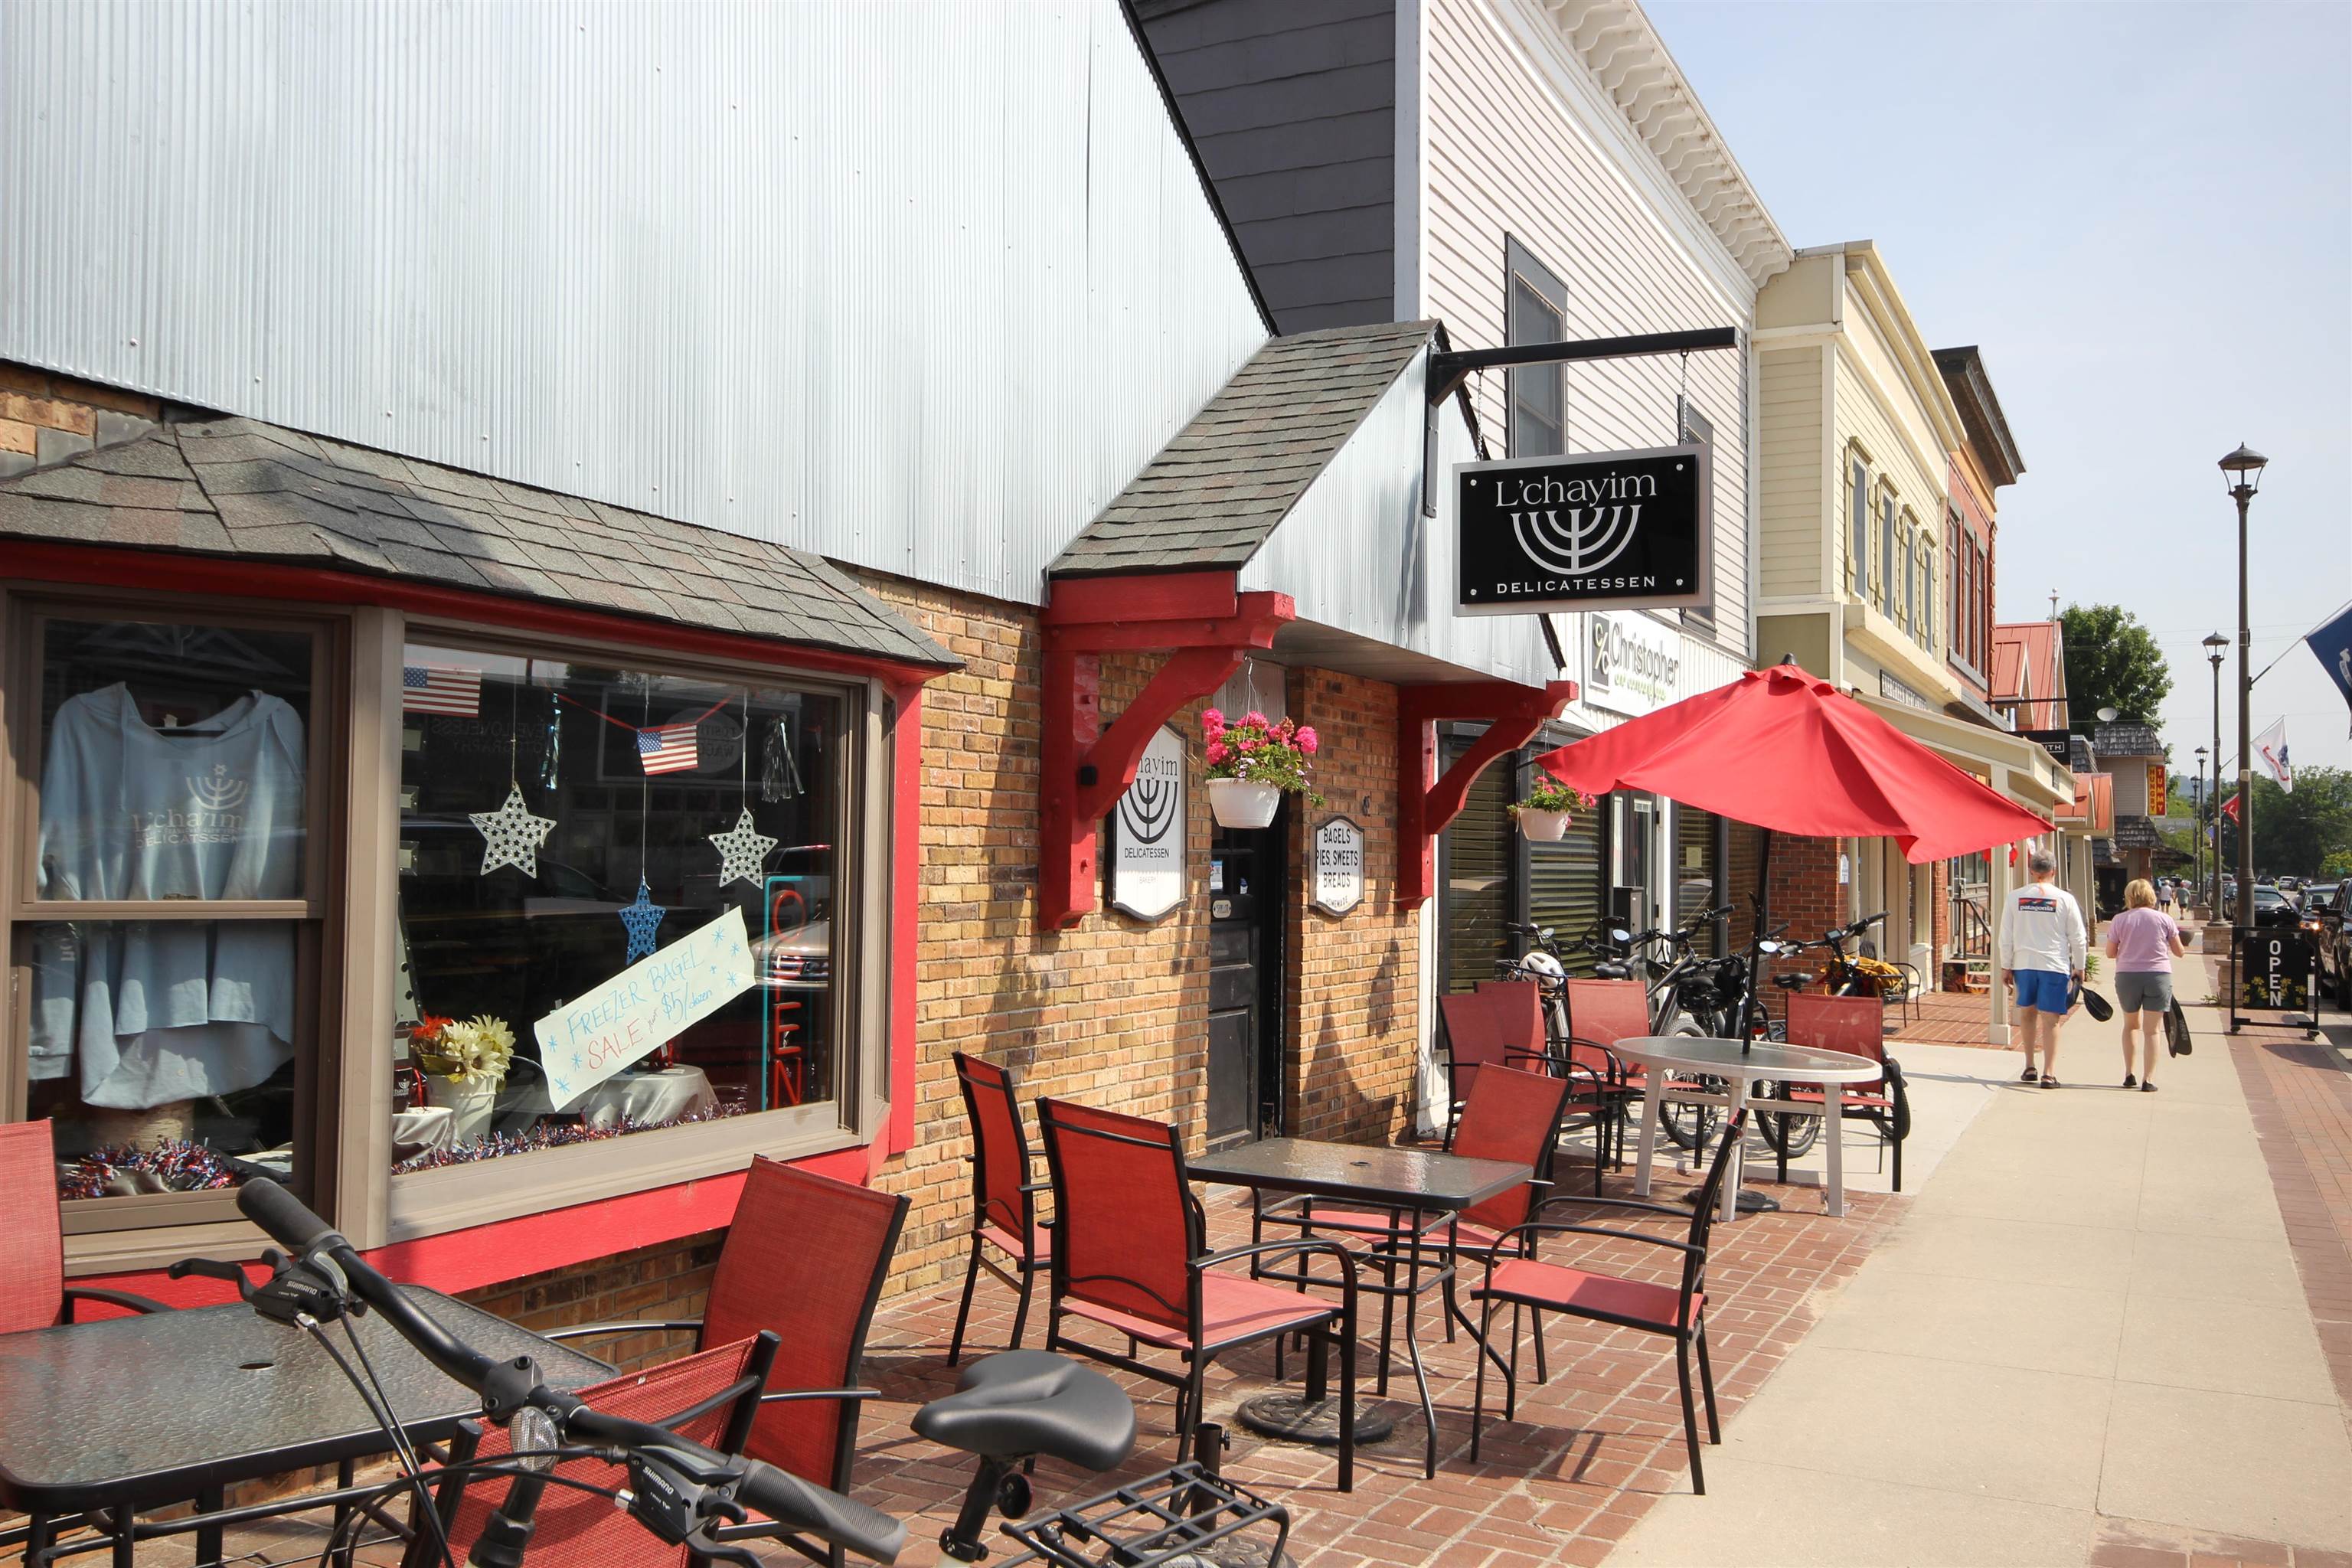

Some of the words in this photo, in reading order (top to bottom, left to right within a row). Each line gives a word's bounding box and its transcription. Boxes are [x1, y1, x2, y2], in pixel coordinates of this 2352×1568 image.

[1495, 472, 1658, 508] L'chayim
[1497, 576, 1655, 594] DELICATESSEN
[1610, 622, 1679, 707] Christopher
[1324, 827, 1351, 844] BAGELS
[1124, 848, 1170, 858] DELICATESSEN
[1333, 850, 1358, 866] SWEETS
[1324, 872, 1351, 888] BREADS
[2269, 939, 2282, 1007] OPEN
[567, 981, 648, 1045] FREEZER
[647, 942, 705, 992] BAGEL
[588, 1018, 643, 1070] SALE
[286, 1280, 318, 1295] SHIMANO
[642, 1465, 675, 1495] SHIMANO
